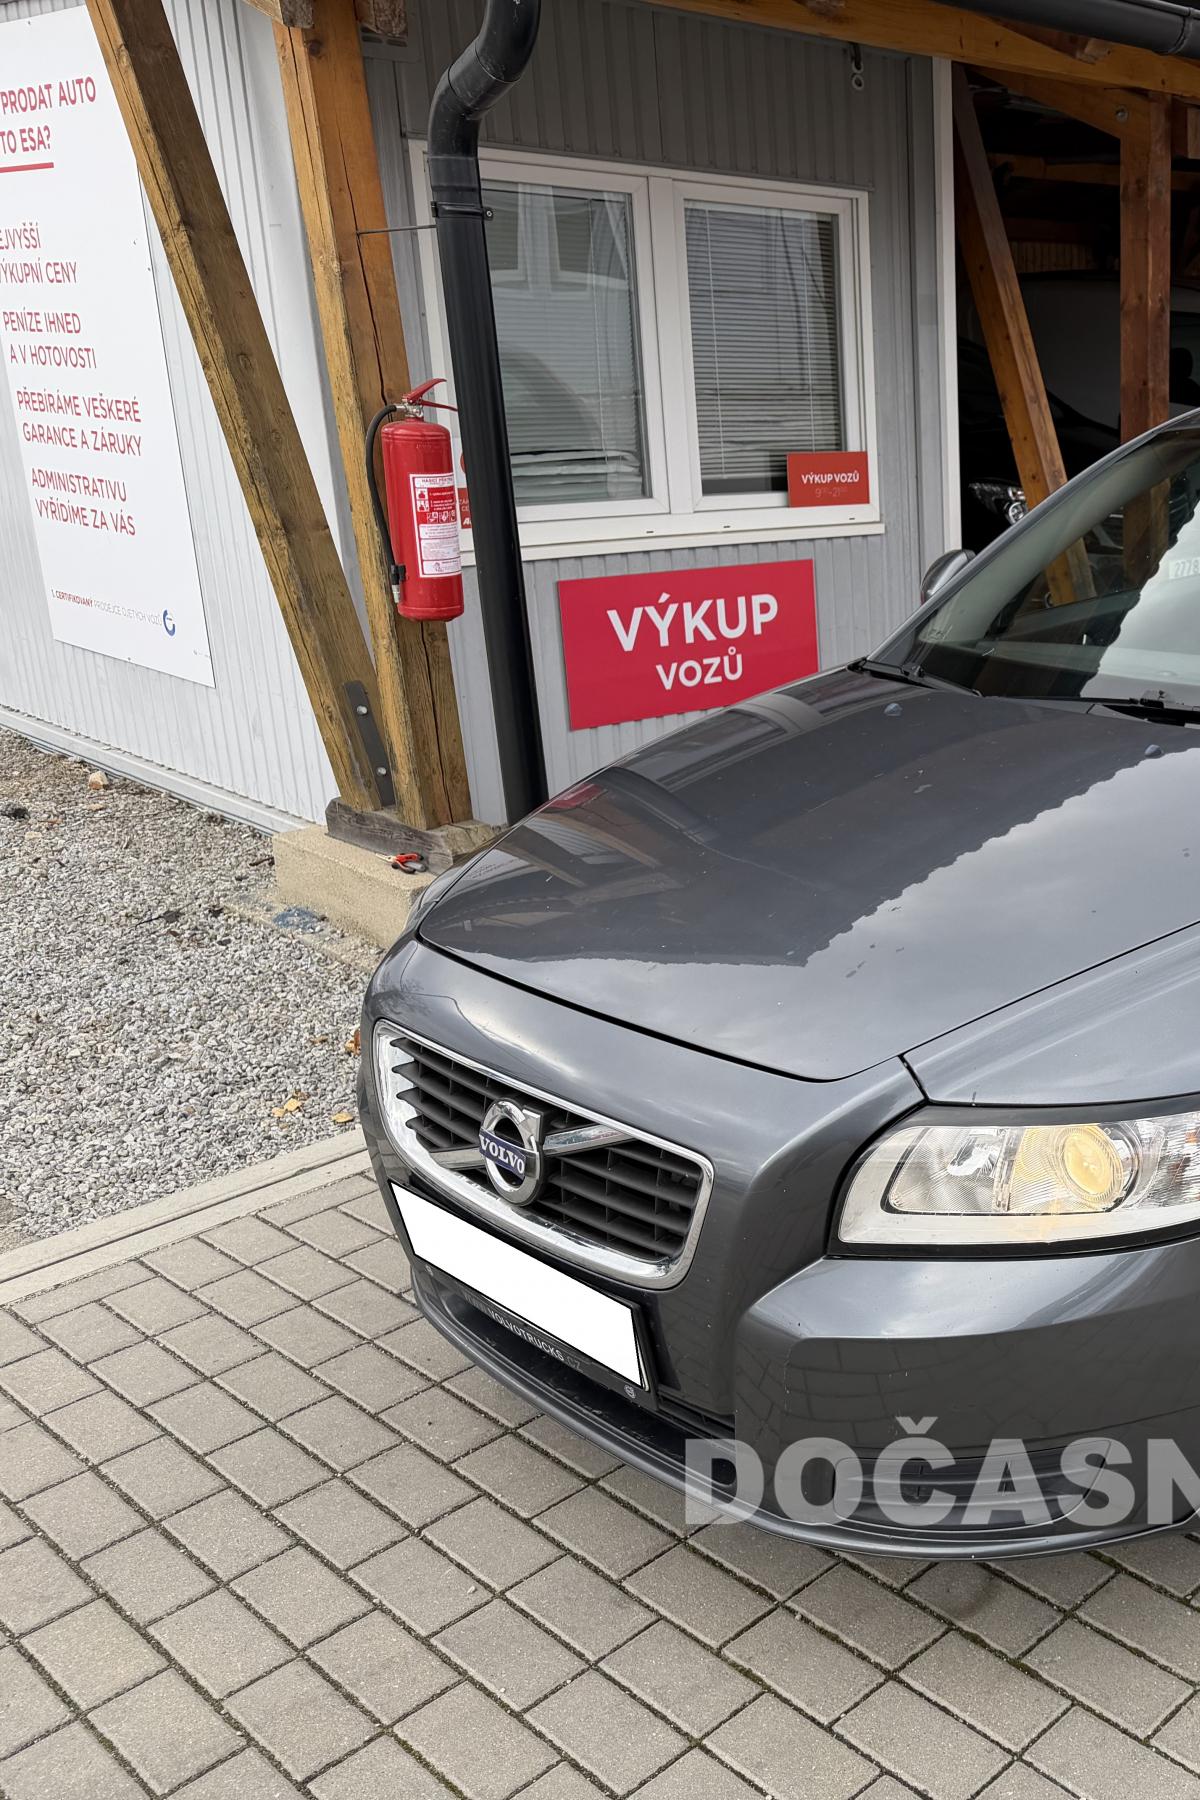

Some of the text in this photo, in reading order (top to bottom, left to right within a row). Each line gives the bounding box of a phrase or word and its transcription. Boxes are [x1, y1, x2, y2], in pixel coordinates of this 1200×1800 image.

[0, 76, 96, 115] PRODAT AUTO
[19, 125, 51, 152] ESA?
[0, 257, 77, 284] ÝKUPNÍ CENY
[2, 307, 81, 334] PENÍZE IHNED
[10, 344, 97, 369] A V HOTOVOSTI
[17, 386, 142, 422] PŘEBÍRÁME VEŠKERÉ
[23, 422, 141, 456] GARANCE A ZÁRUKY
[31, 468, 127, 502] ADMINISTRATIVU
[801, 469, 860, 484] VÝKUP VOZŮ
[35, 496, 136, 536] VYŘÍDÍME ZA VÁS
[606, 592, 779, 652] VÝKUP
[656, 646, 743, 690] VOZŮ
[479, 1134, 524, 1174] VOLVO
